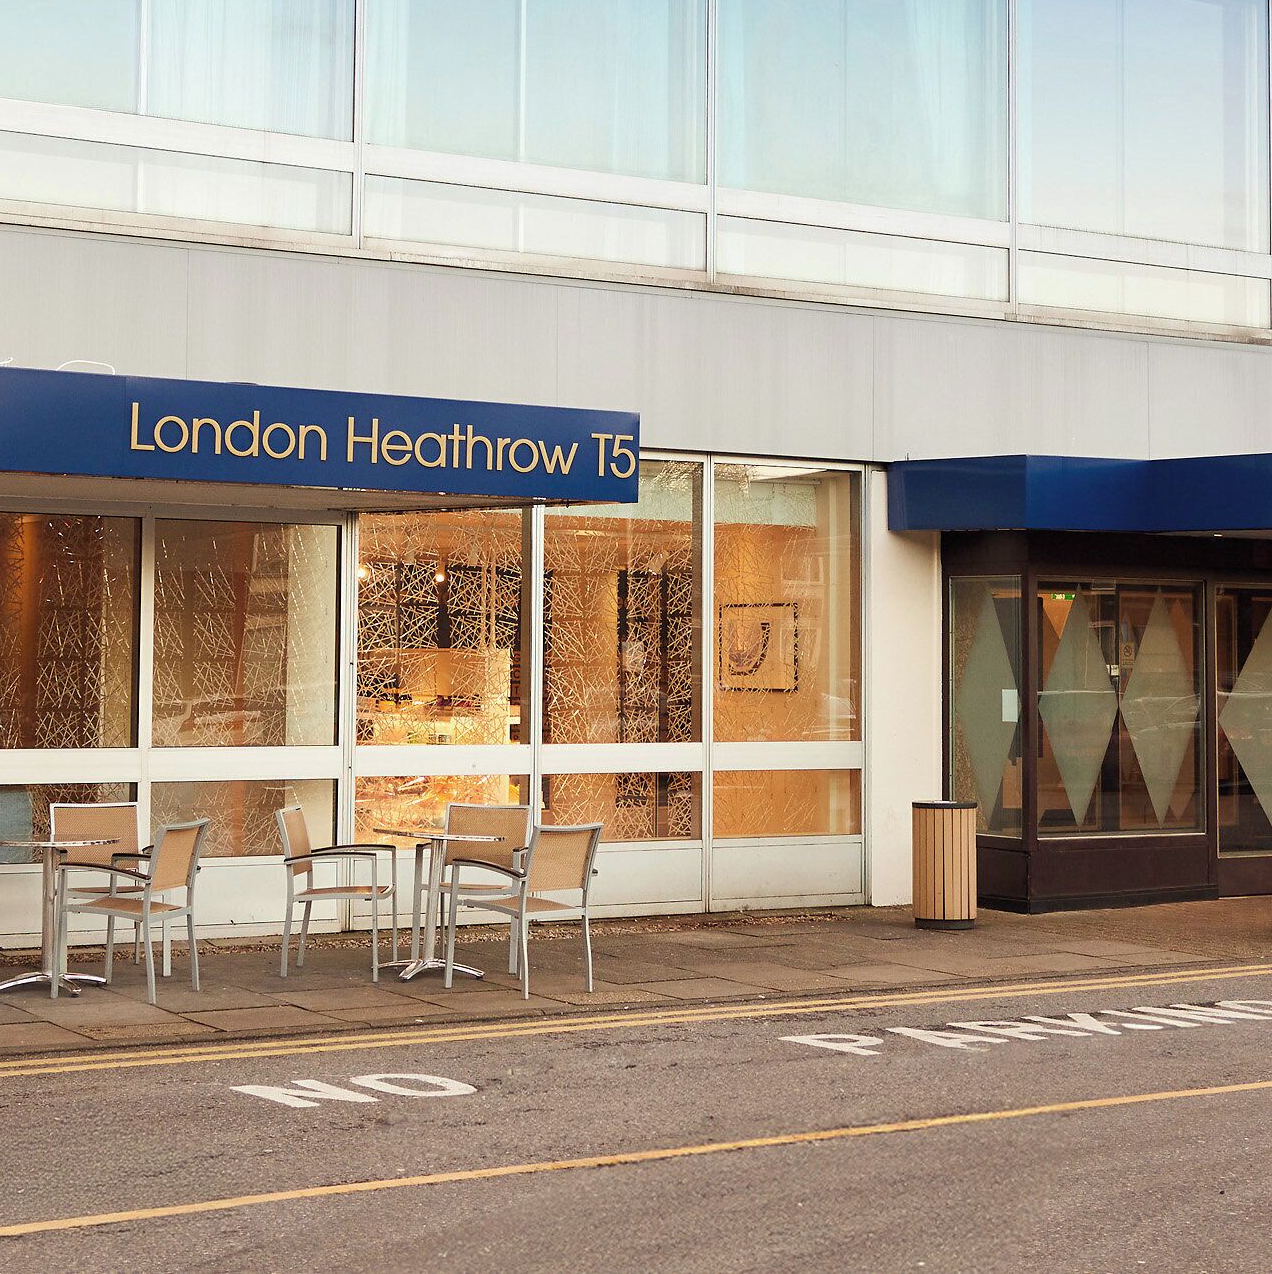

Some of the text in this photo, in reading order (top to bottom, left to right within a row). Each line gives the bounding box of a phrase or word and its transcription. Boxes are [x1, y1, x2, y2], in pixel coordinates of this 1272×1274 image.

[130, 402, 636, 479] London Heathrow T5
[229, 1073, 478, 1108] NO
